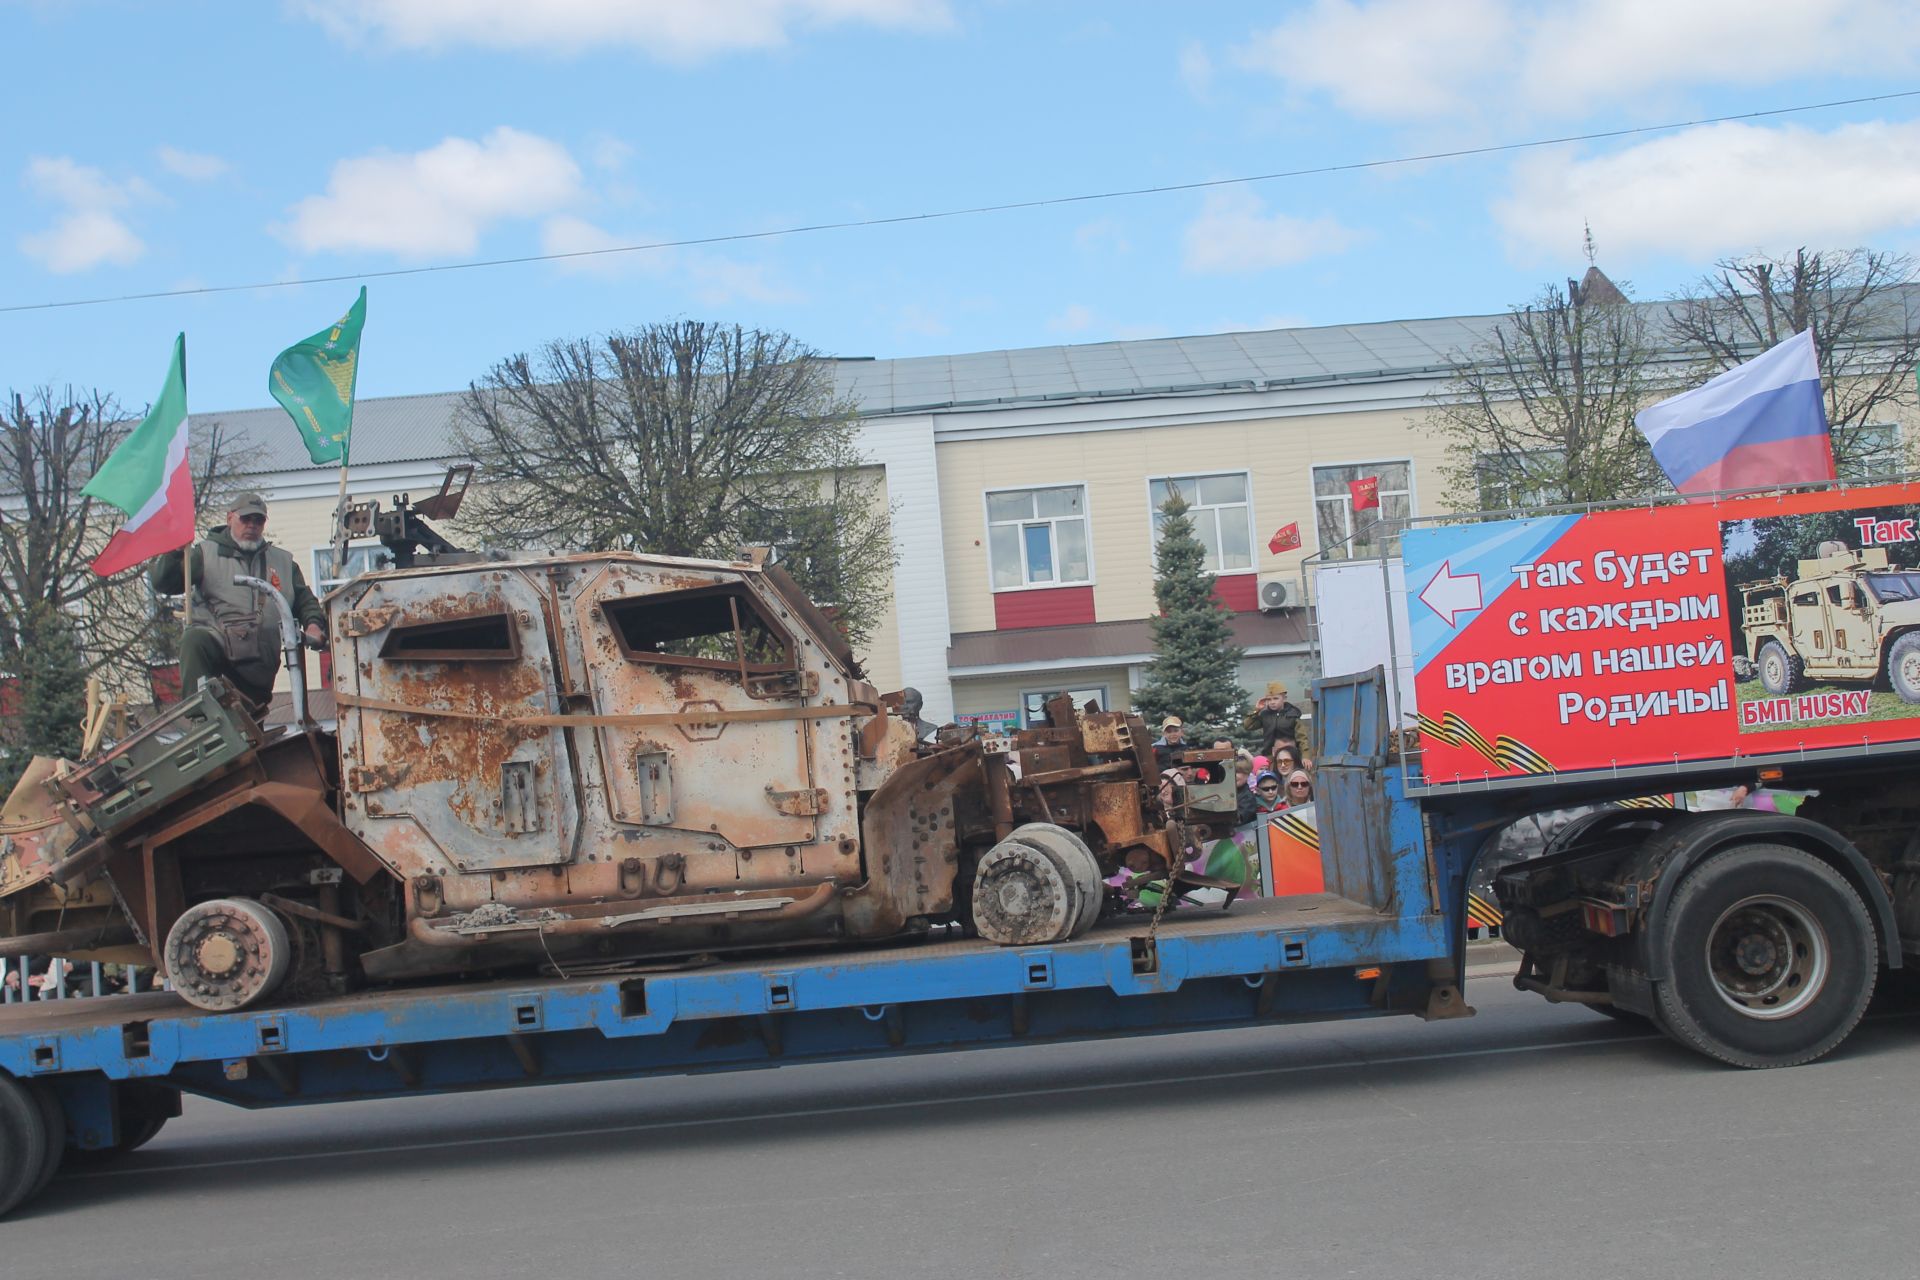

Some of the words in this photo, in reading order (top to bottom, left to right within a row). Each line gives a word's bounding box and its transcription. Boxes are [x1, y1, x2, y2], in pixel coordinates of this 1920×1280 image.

[1854, 516, 1915, 545] Так
[1593, 548, 1713, 589] будет
[1507, 611, 1530, 636] с
[1539, 593, 1720, 634] каждым
[1445, 652, 1582, 693] врагом
[1592, 634, 1725, 675] нашей
[1557, 679, 1729, 727] Родины!
[1742, 698, 1792, 726] БМП
[1797, 690, 1871, 720] HUSKY
